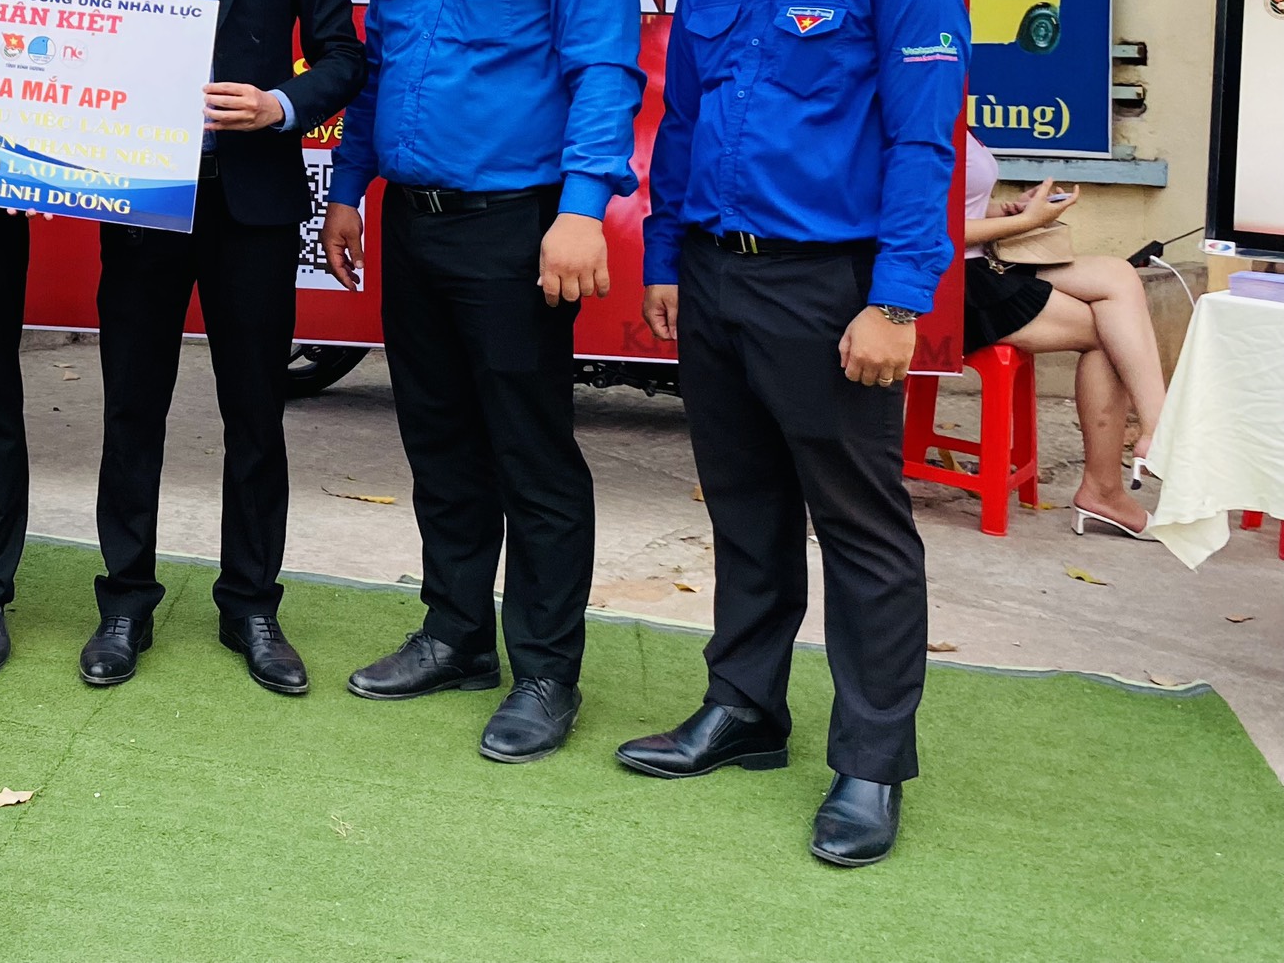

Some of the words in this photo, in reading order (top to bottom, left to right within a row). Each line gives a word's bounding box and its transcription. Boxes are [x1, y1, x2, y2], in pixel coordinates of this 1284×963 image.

[118, 0, 164, 14] NHÂN
[170, 5, 203, 19] LỰC
[56, 9, 123, 36] KIỆT
[21, 75, 73, 105] MẮT
[78, 87, 128, 110] APP
[137, 124, 189, 144] CHO
[27, 140, 107, 160] THANH
[8, 159, 57, 178] LAO
[47, 189, 131, 215] DƯƠNG
